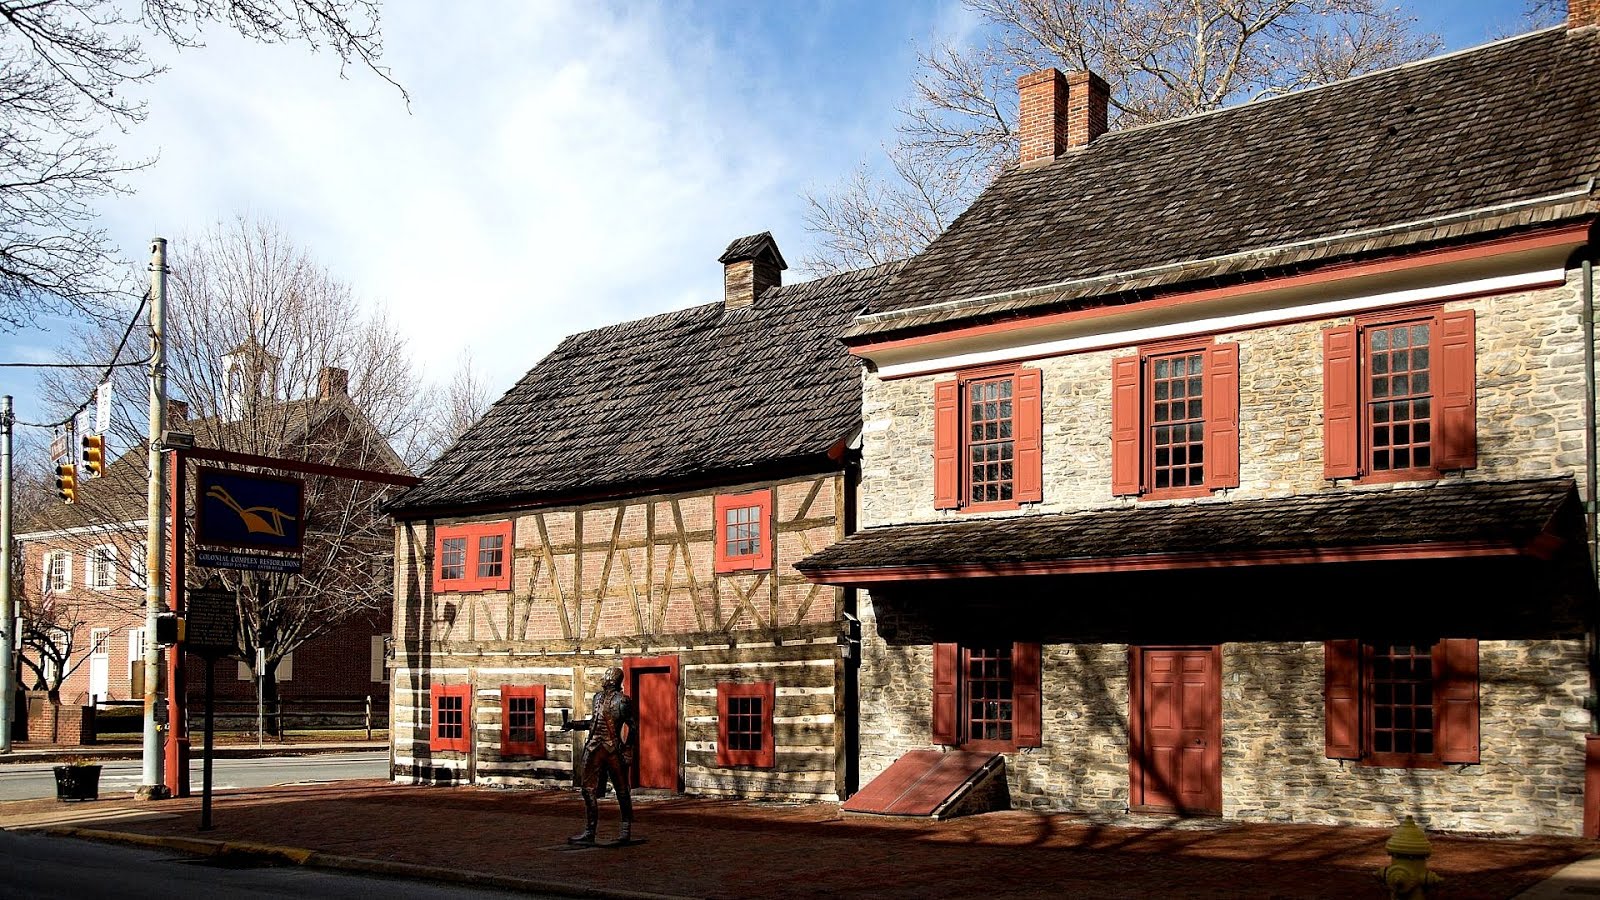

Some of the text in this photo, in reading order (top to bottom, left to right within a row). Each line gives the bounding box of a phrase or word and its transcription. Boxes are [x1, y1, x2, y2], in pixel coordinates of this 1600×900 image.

[198, 553, 300, 567] COLONIAL COMPLEX RESTORATIONS
